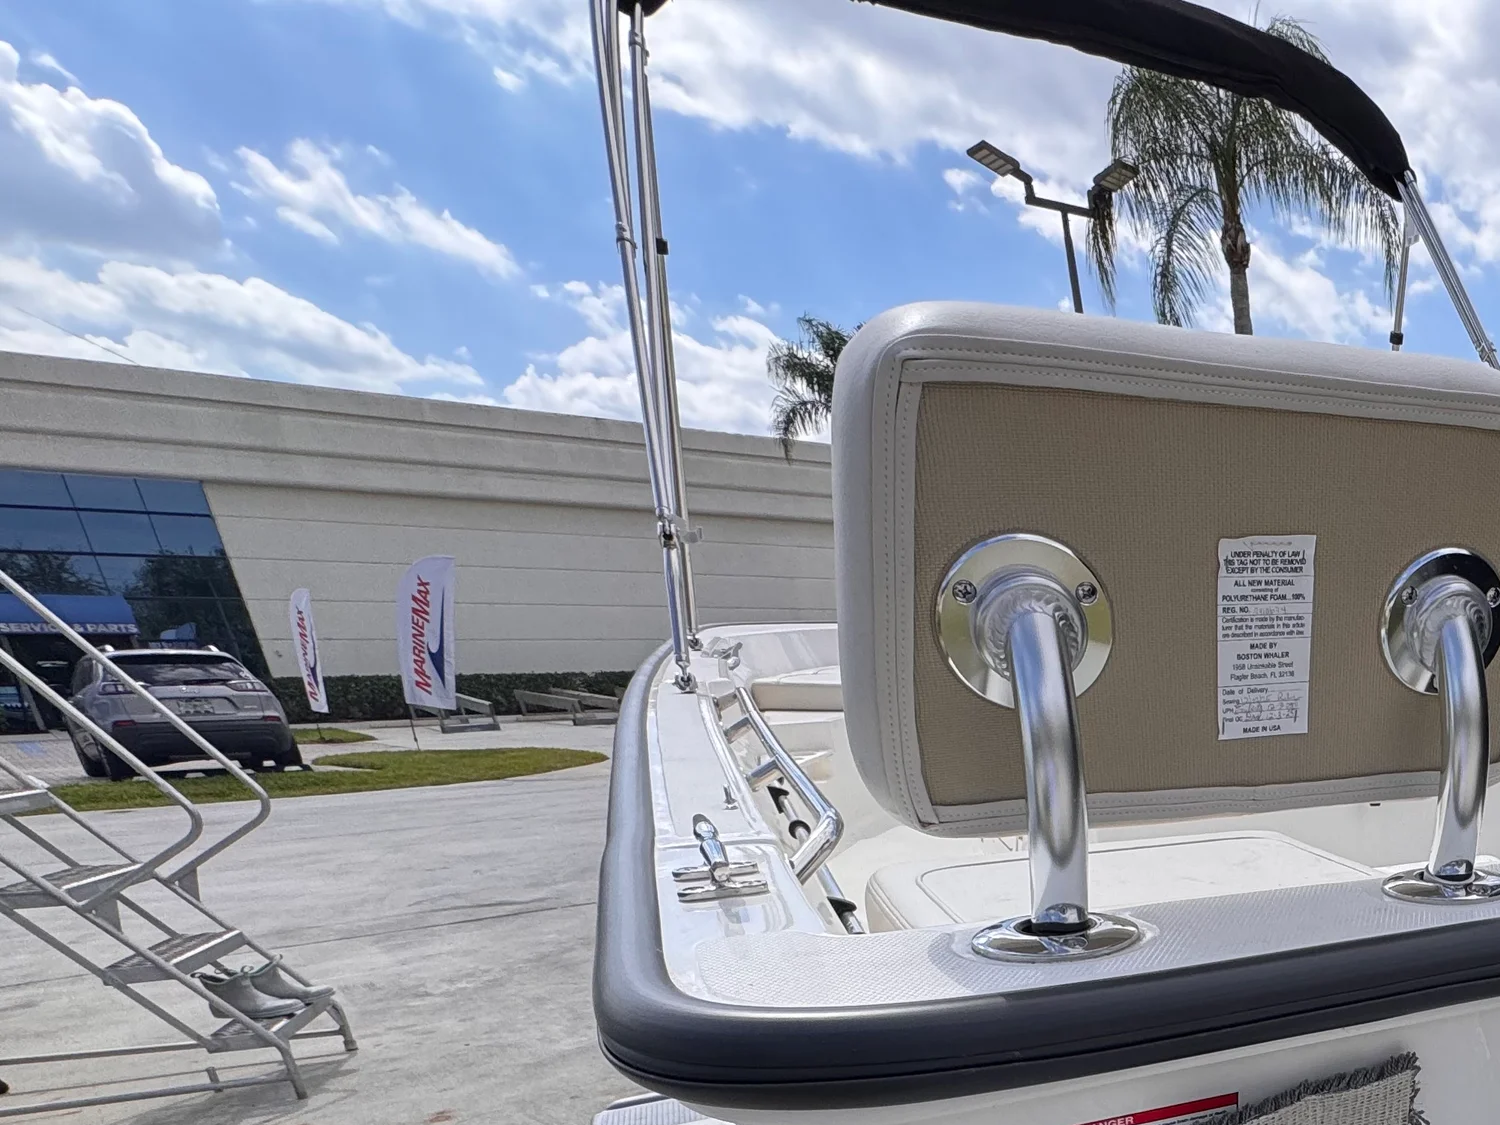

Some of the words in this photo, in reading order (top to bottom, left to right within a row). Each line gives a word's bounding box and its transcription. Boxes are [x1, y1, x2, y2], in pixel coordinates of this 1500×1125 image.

[1230, 550, 1252, 558] UNDER
[1252, 550, 1278, 558] PENALTY
[1279, 550, 1287, 558] OF
[1288, 550, 1301, 558] LAW
[1226, 566, 1250, 574] EXCEPT
[1250, 566, 1259, 574] BY
[1233, 579, 1247, 587] ALL
[1247, 579, 1263, 587] NEW
[1264, 578, 1295, 587] MATERIAL
[1221, 594, 1269, 602] POLYURETHANE
[0, 622, 62, 634] SERVIC
[86, 623, 138, 633] PARTS
[1249, 642, 1267, 650] MADE
[1264, 651, 1290, 659] WHALER
[1242, 726, 1260, 734] MADE
